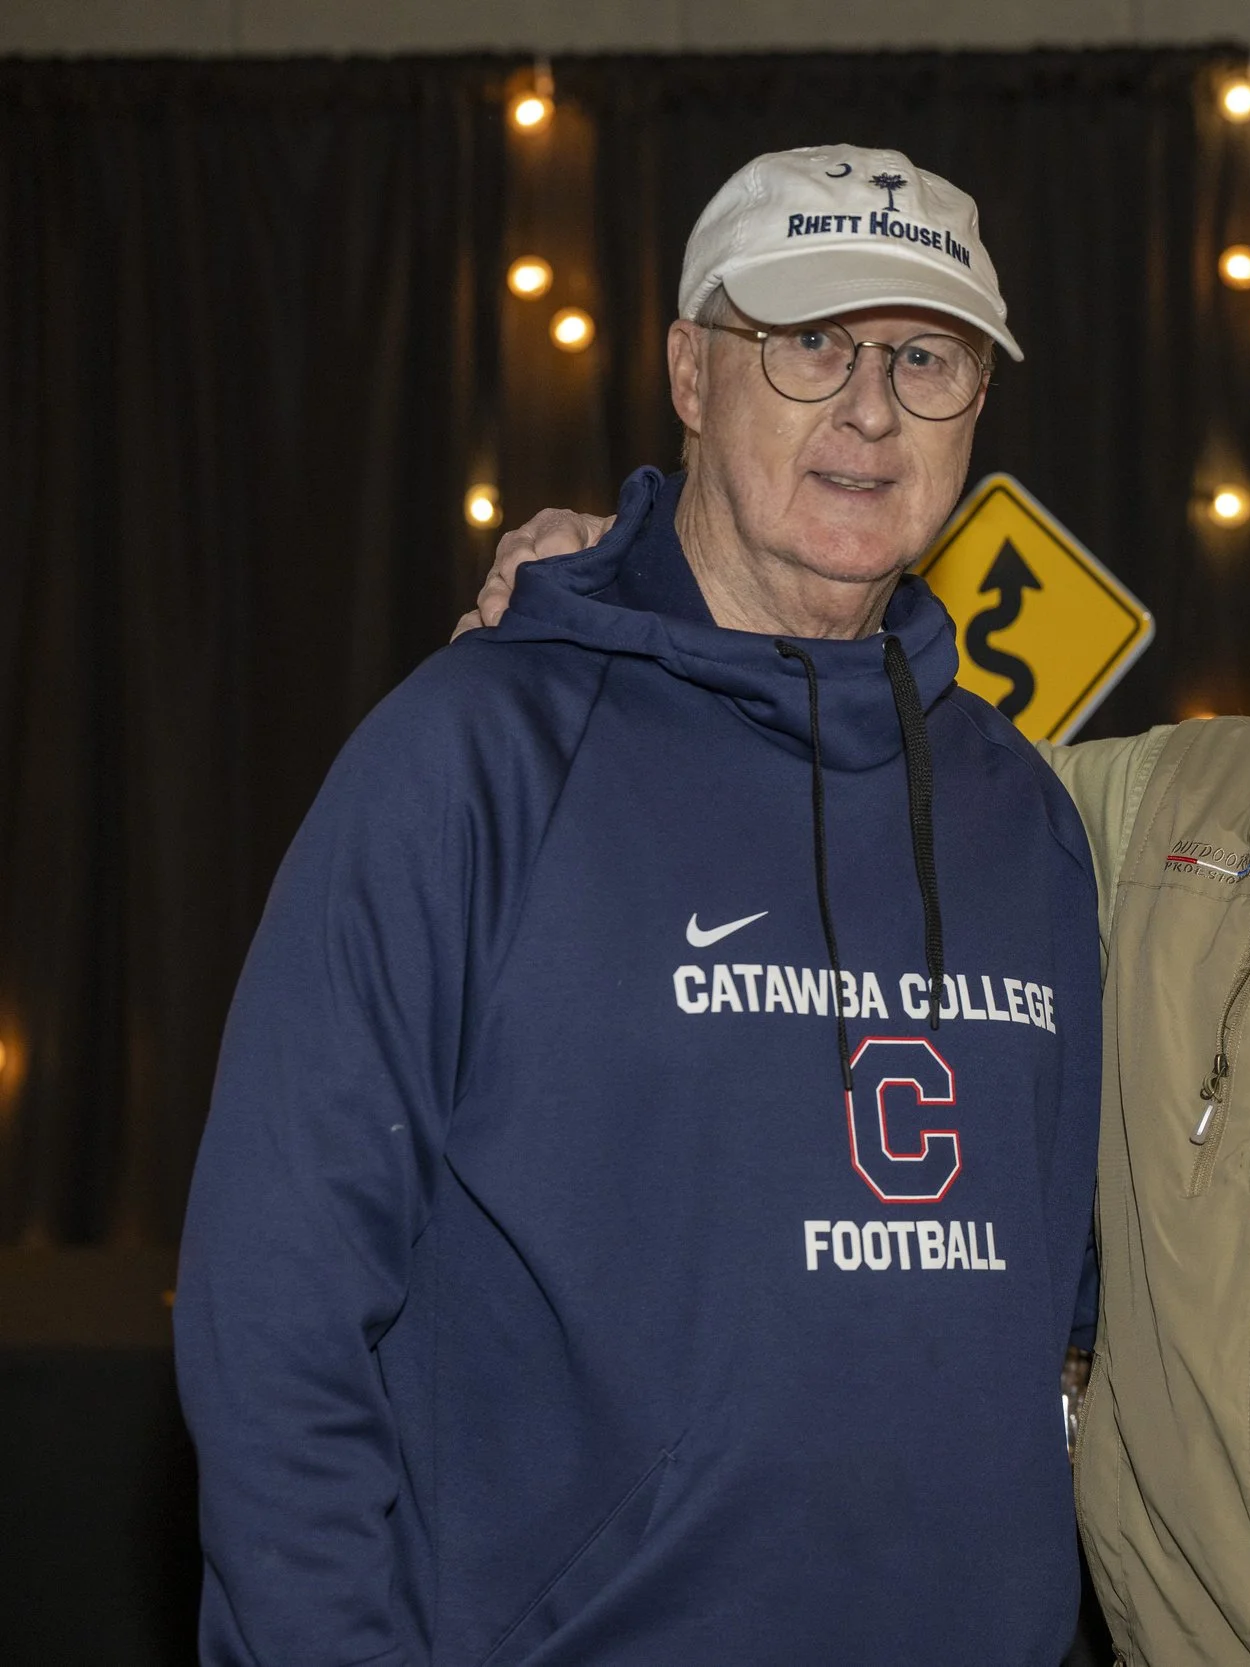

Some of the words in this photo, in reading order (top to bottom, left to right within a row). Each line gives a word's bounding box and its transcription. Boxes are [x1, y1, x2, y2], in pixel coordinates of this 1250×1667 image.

[787, 213, 862, 238] RHETT
[869, 211, 942, 252] HOUSE
[945, 230, 972, 269] INN
[672, 963, 889, 1020] CATAWBA
[899, 972, 1057, 1034] COLLEGE
[844, 1036, 962, 1203] C
[804, 1220, 1006, 1271] FOOTBALL
